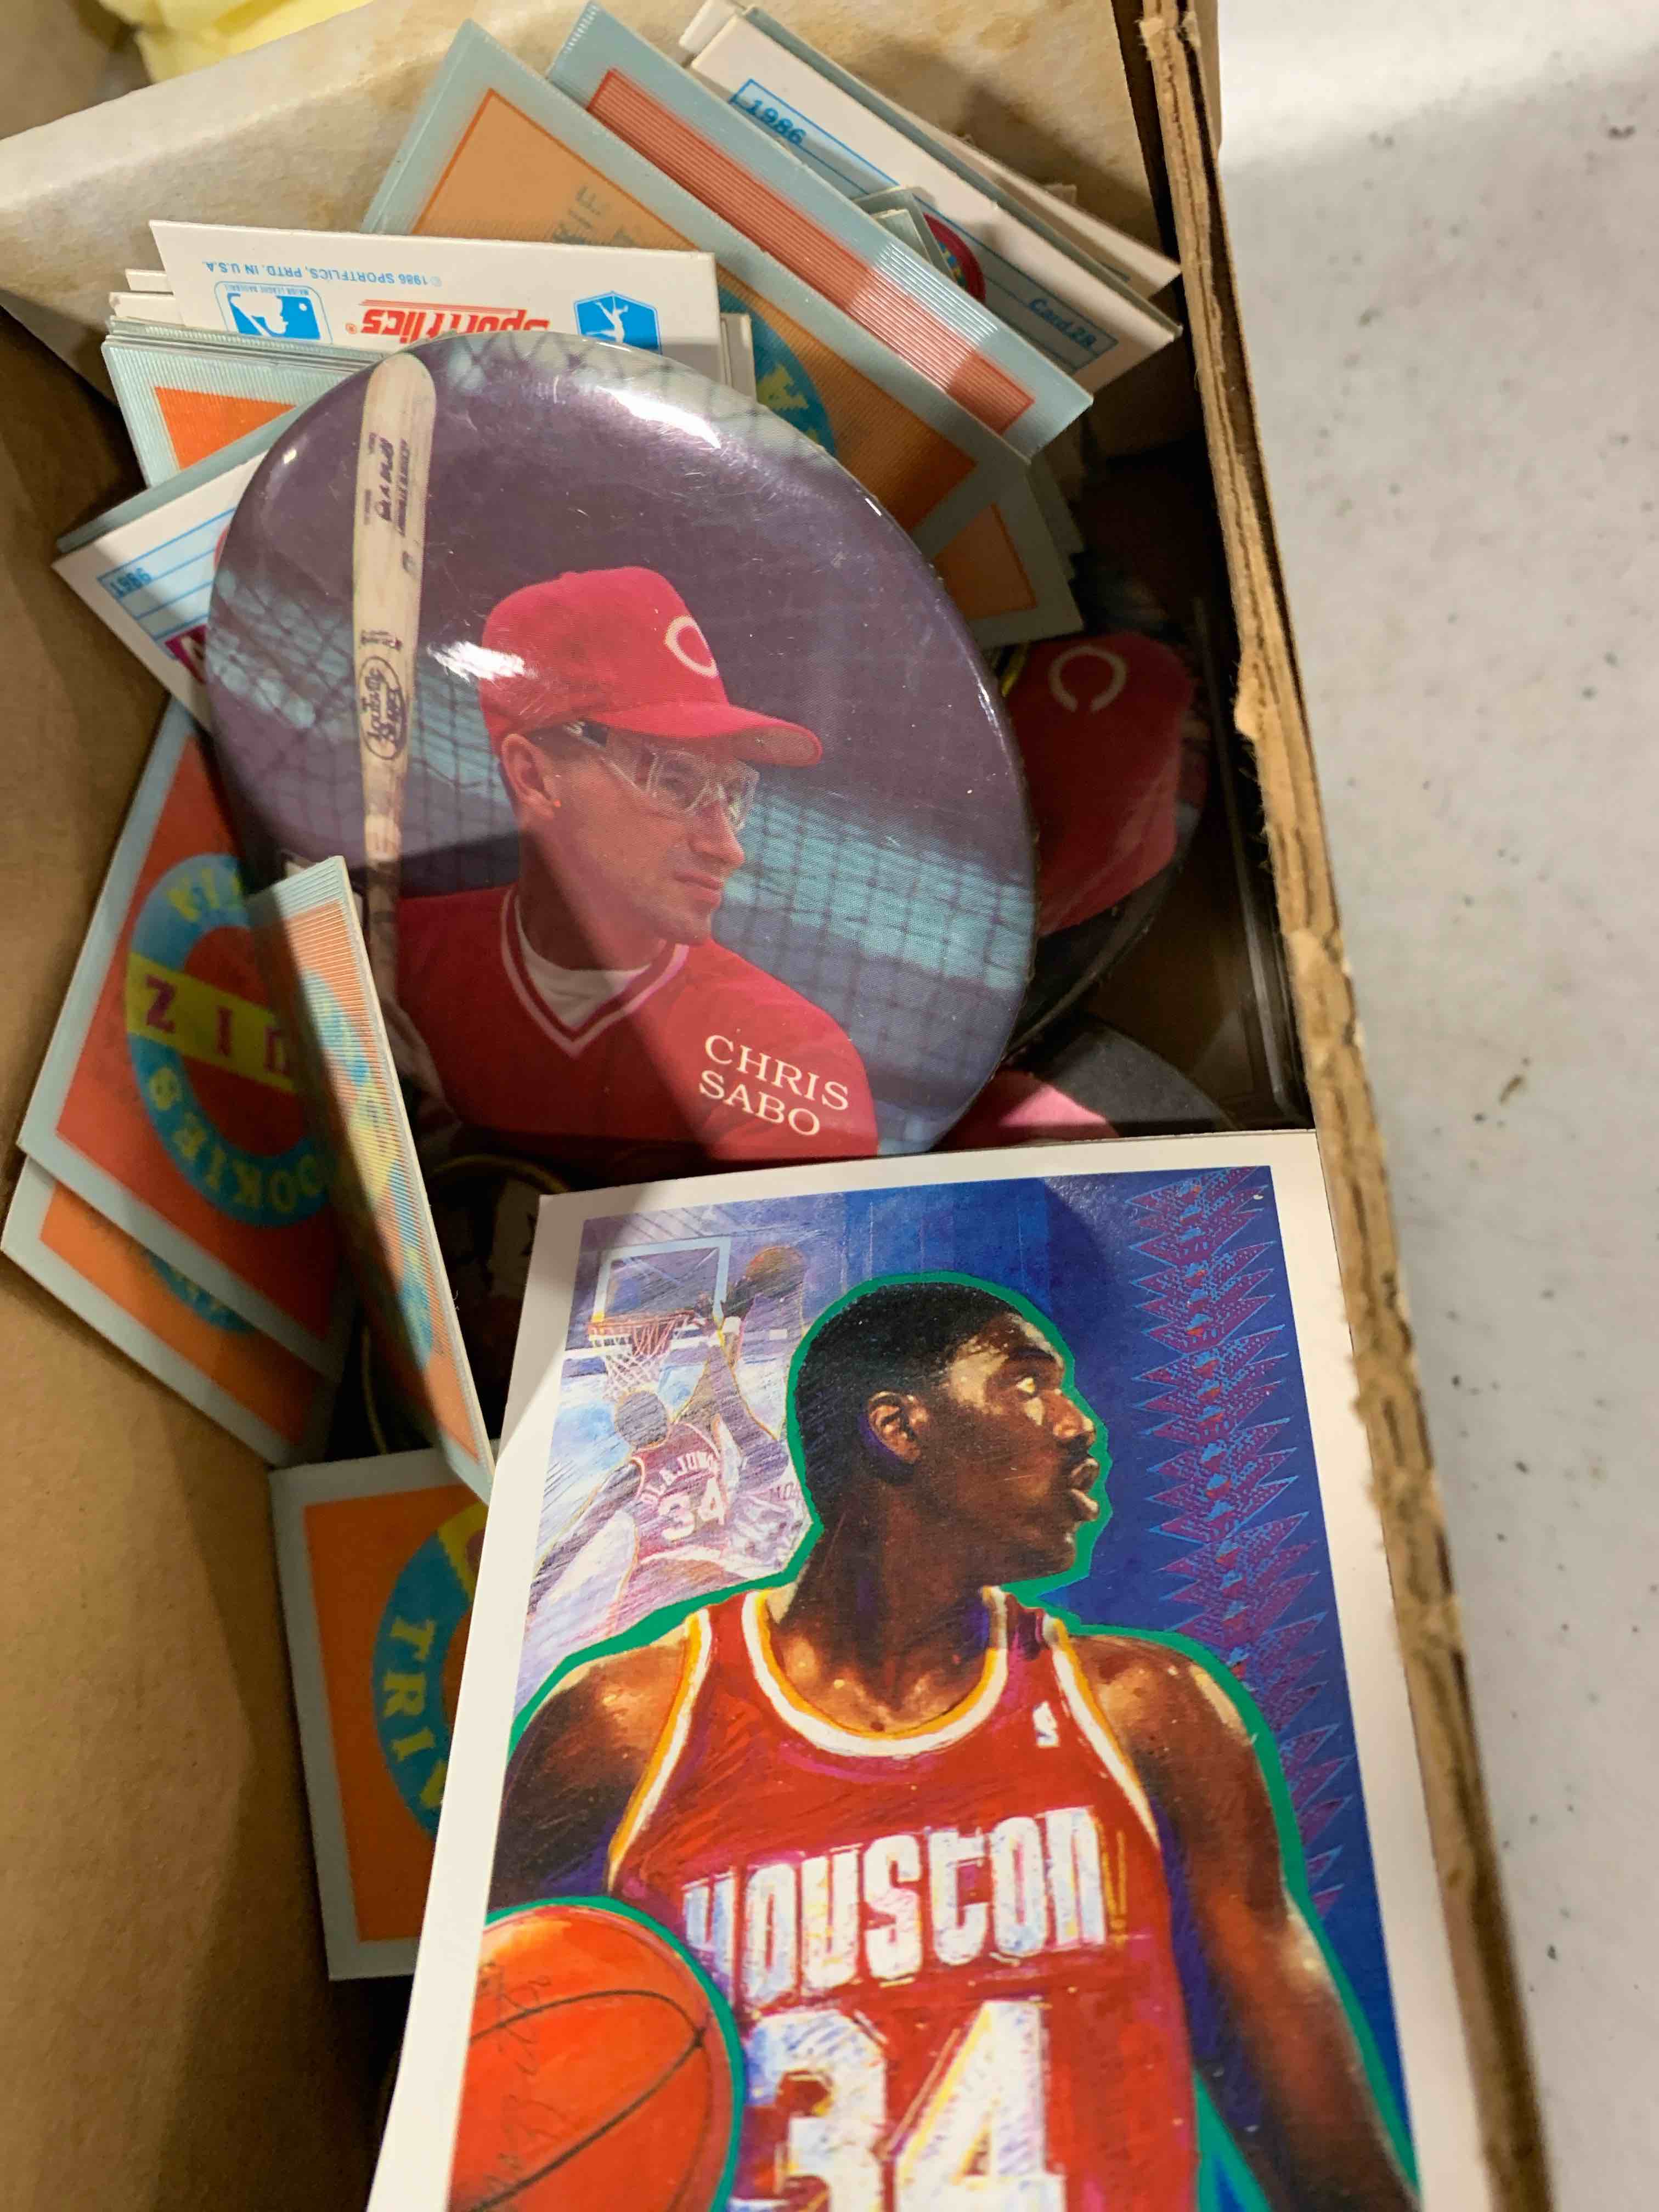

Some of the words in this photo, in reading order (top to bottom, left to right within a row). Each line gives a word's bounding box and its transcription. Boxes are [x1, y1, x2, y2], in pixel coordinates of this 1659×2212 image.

[747, 100, 806, 145] 1986
[245, 264, 259, 275] IN
[398, 273, 428, 286] 1986
[665, 615, 718, 678] C
[705, 1035, 849, 1111] CHRIS
[699, 1070, 821, 1136] SABO
